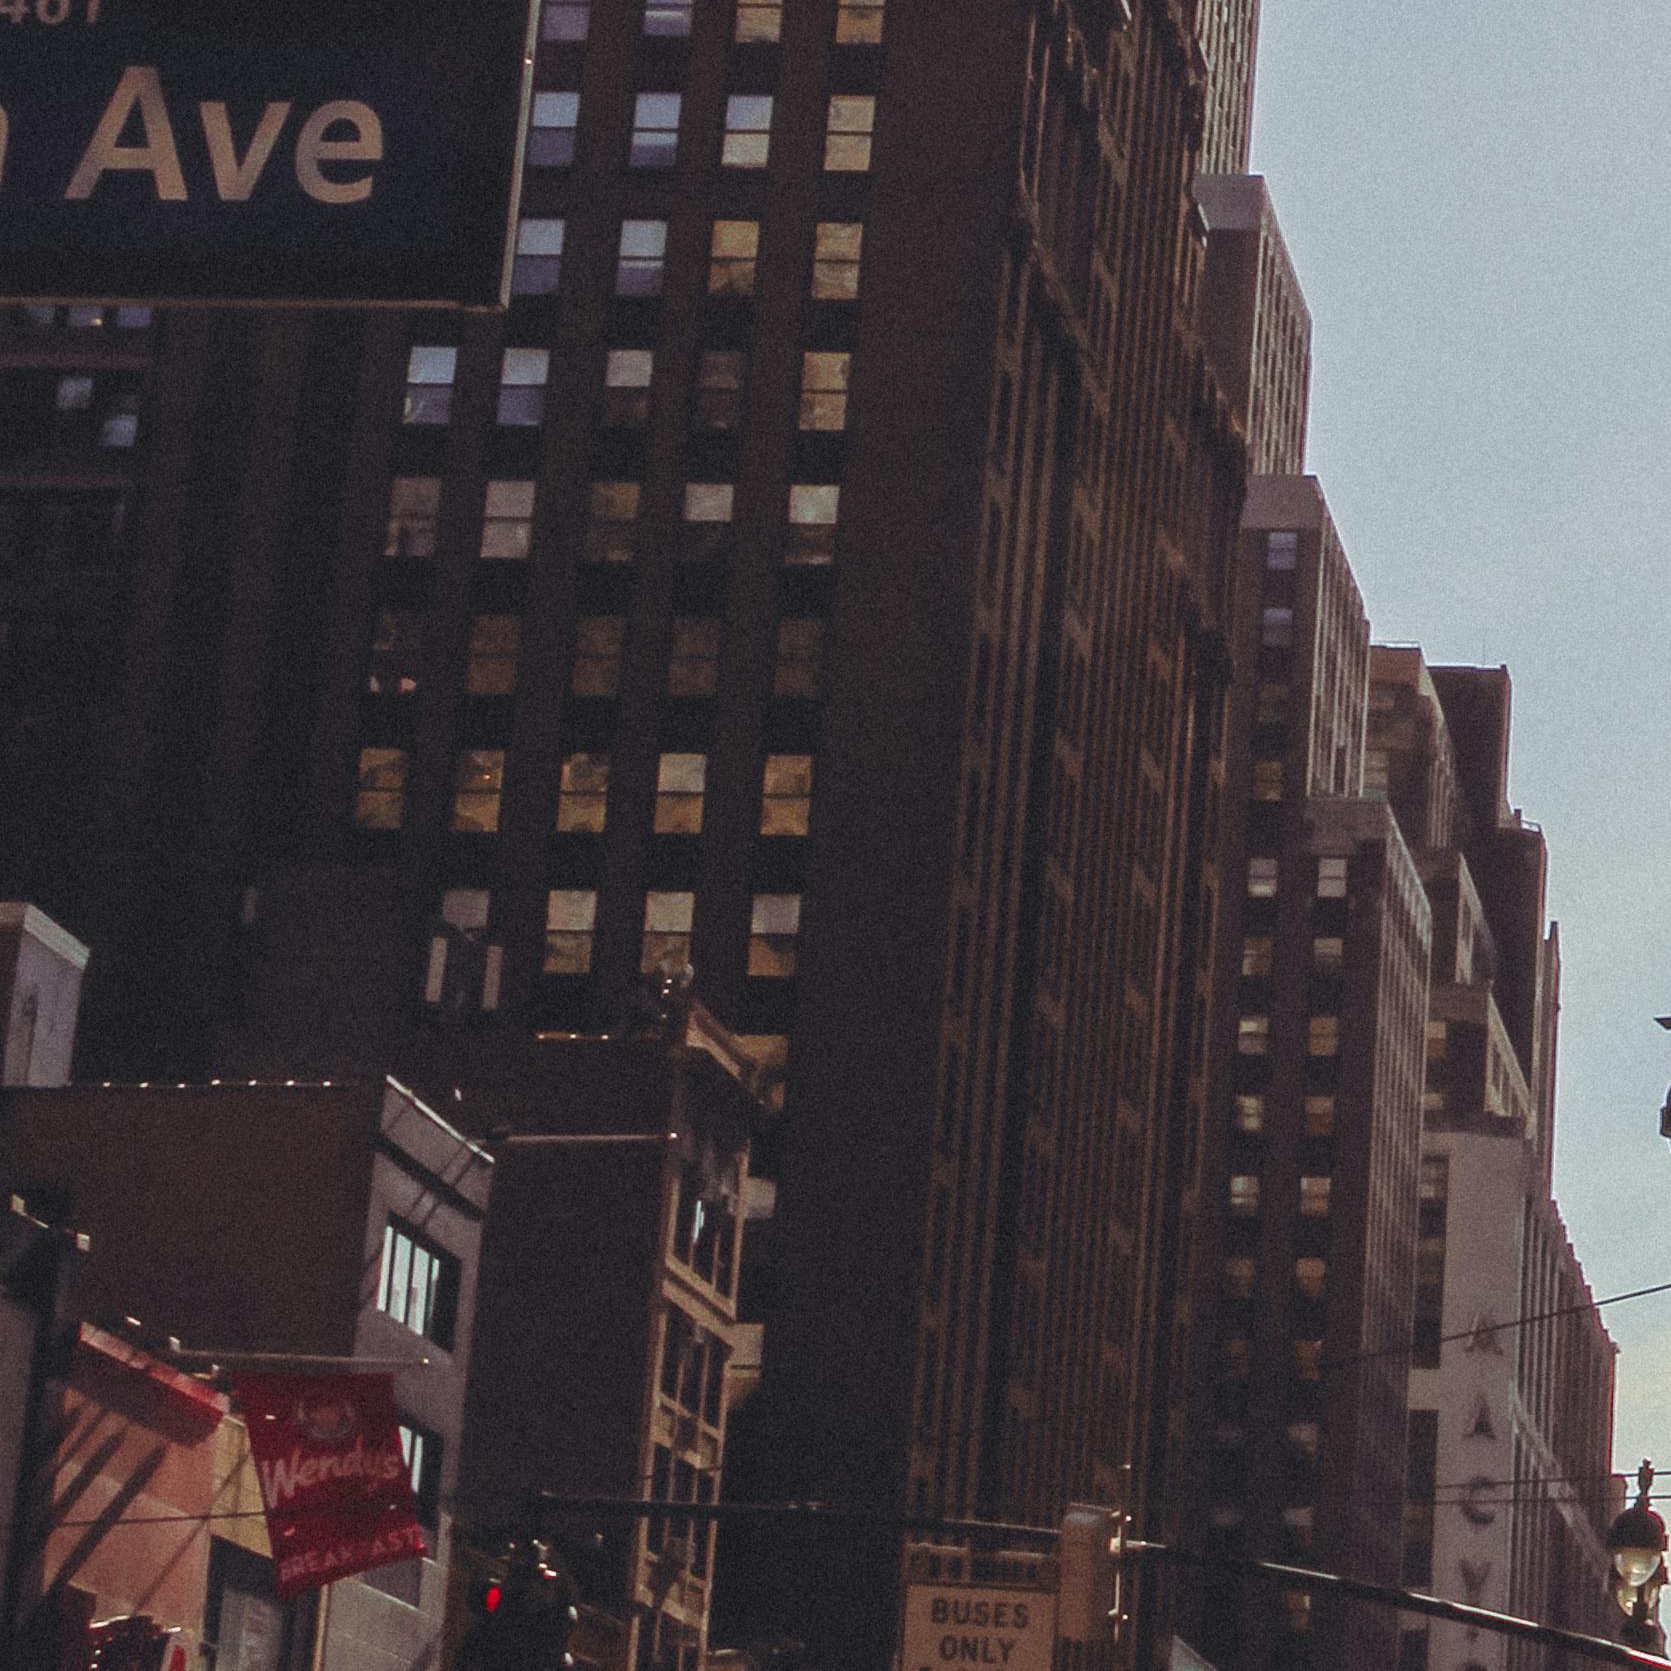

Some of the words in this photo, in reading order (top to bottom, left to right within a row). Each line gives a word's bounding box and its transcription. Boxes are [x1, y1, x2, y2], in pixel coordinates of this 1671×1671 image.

[63, 65, 384, 204] Ave
[931, 1598, 1029, 1629] BUSES
[939, 1635, 1016, 1663] ONLY
